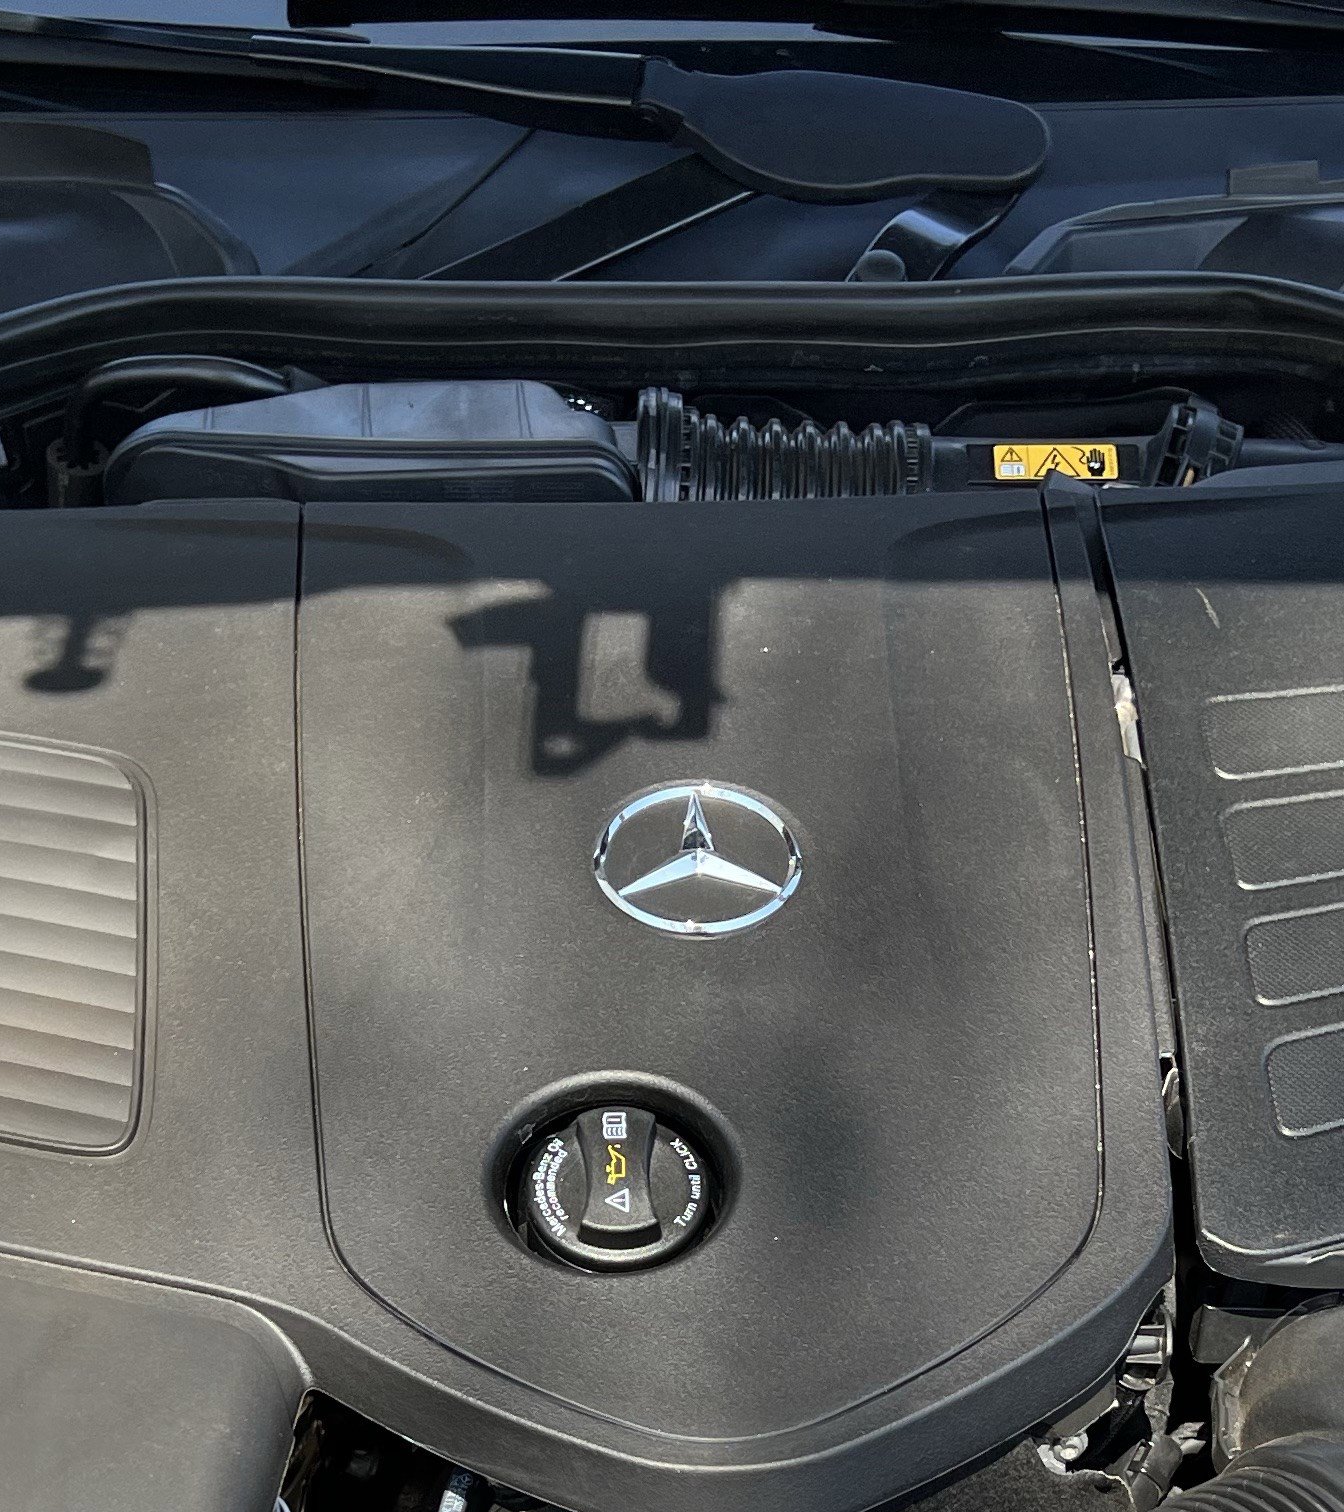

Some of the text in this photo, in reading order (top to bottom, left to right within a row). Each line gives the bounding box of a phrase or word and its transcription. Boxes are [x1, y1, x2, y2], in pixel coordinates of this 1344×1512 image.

[532, 1153, 567, 1237] Mercedes-Benz
[545, 1149, 569, 1220] recommended
[669, 1137, 701, 1227] Turn until CLICK
